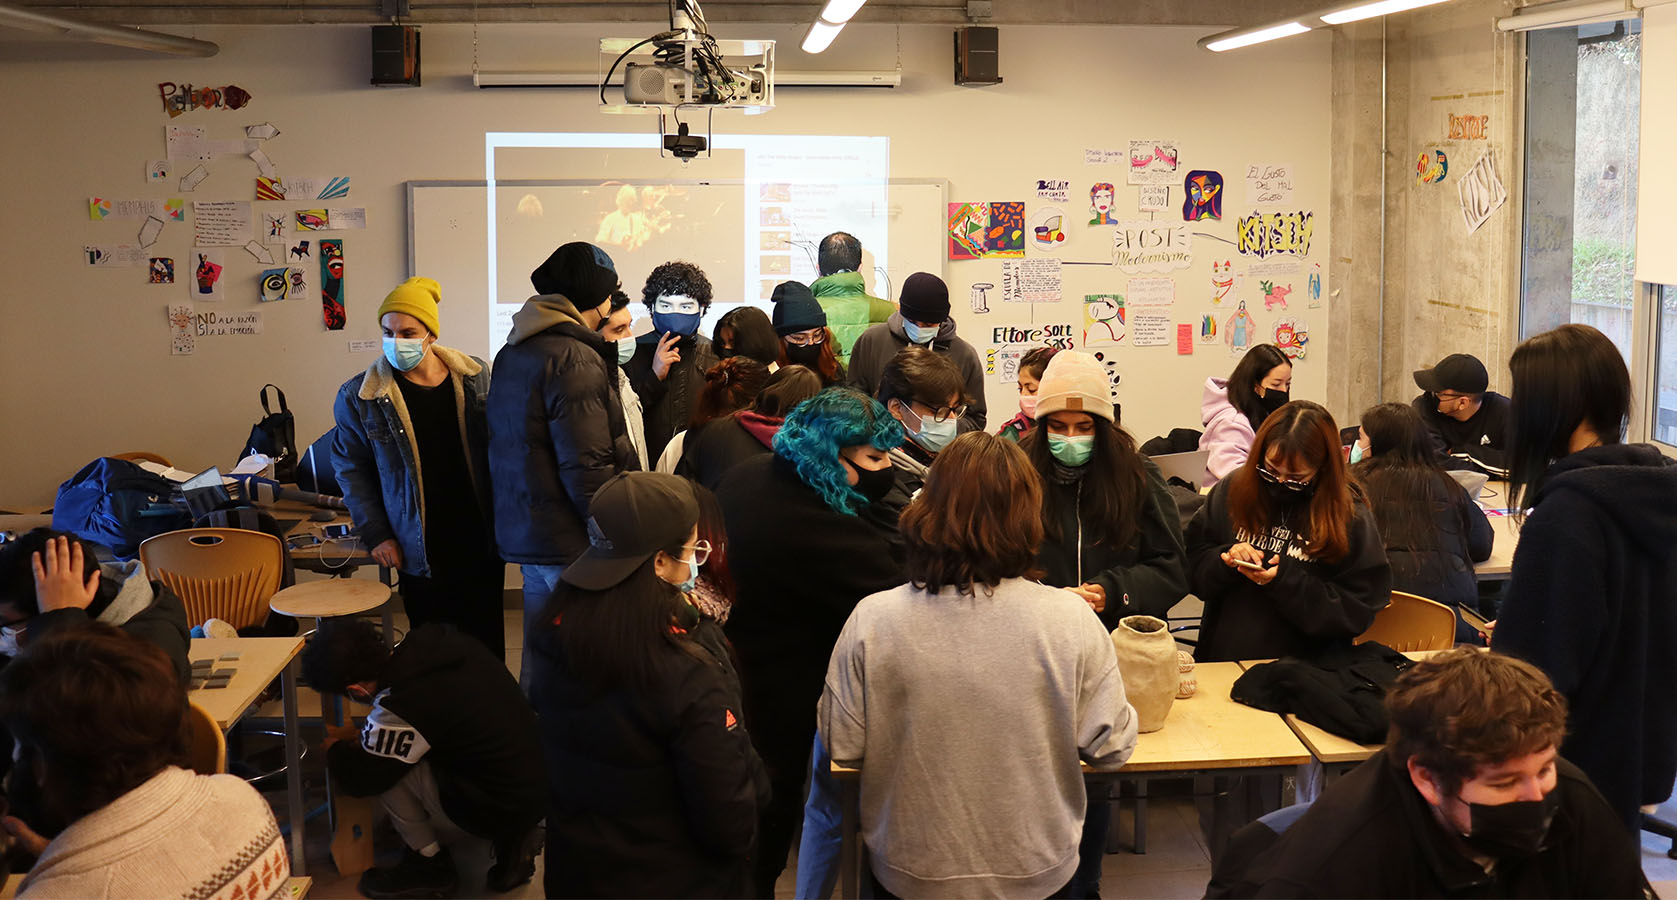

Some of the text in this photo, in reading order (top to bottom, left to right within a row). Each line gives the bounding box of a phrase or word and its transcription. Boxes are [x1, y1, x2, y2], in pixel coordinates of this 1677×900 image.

[117, 200, 157, 216] MEMPHIS
[1125, 228, 1178, 249] POST
[1238, 212, 1313, 255] KITSCH
[1113, 250, 1190, 266] Modernismo
[197, 312, 216, 325] NO
[198, 324, 208, 336] SI
[993, 327, 1043, 344] Ettore
